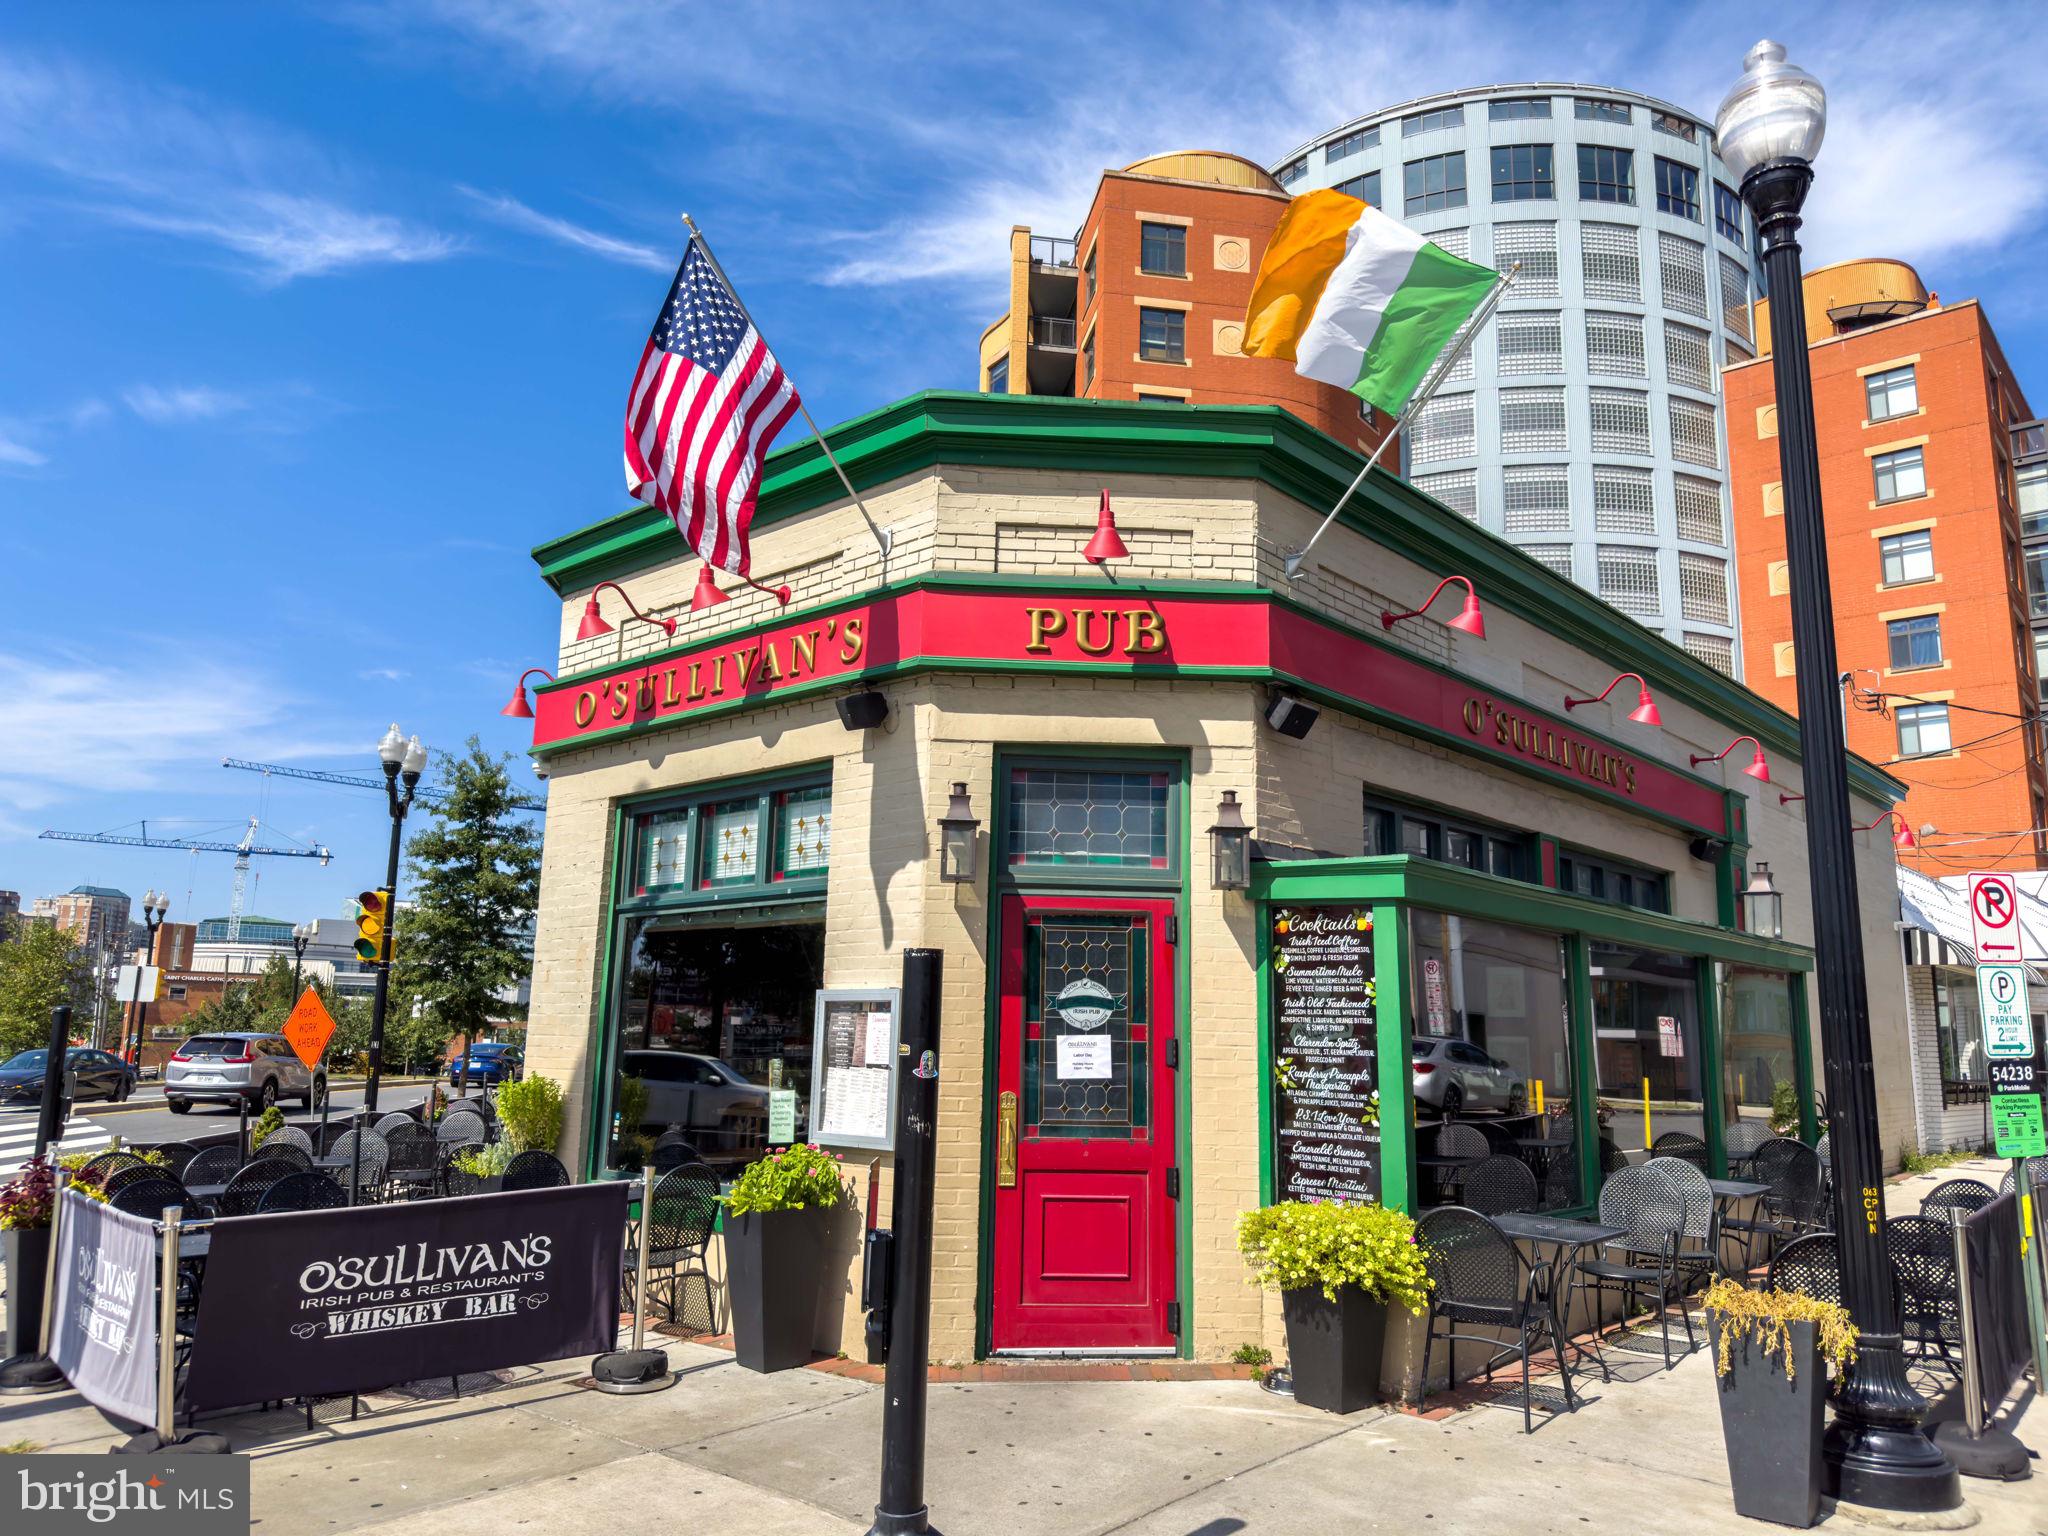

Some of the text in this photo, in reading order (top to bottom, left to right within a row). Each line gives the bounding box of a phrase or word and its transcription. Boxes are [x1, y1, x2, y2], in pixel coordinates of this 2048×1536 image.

[1025, 608, 1166, 654] PUB
[573, 619, 864, 728] O'SULLIVAN'S
[1463, 697, 1637, 794] O'SULLIVAN'S
[1289, 914, 1356, 934] Cocktails
[1288, 935, 1360, 950] Irish Iced Coffee
[1287, 964, 1364, 976] Summertime Mule
[1064, 982, 1078, 995] FOOD
[1998, 976, 2008, 999] P
[1282, 996, 1371, 1008] Irish Old Fashioned
[299, 1008, 317, 1018] ROAD
[1998, 1004, 2012, 1014] PAY
[1990, 1016, 2023, 1025] PARKING
[299, 1023, 318, 1033] WORK
[1998, 1027, 2005, 1042] 2
[297, 1037, 321, 1048] AHEAD
[1294, 1035, 1361, 1053] Clarendon Spritz
[1288, 1065, 1370, 1085] Raspberry Pineapple
[1992, 1066, 2033, 1082] 54238
[1306, 1079, 1351, 1093] Margarita
[1286, 1089, 1308, 1097] MILAGRO,
[1299, 1098, 1324, 1106] PINEAPPLE
[1296, 1108, 1359, 1127] P.S. I Love You
[1313, 1123, 1343, 1131] STRAWBERRY
[1338, 1133, 1362, 1141] CHOCOLATE
[1292, 1140, 1366, 1158] Emerald Sunrise
[1290, 1153, 1311, 1161] JAMESON
[1312, 1156, 1332, 1164] ORANGE,
[1332, 1157, 1349, 1165] MELON
[1343, 1166, 1360, 1174] SPRITE
[1291, 1171, 1368, 1192] Espresso Martini
[1288, 1185, 1305, 1193] KETTLE
[1863, 1187, 1877, 1196] 063
[1863, 1198, 1878, 1208] CP
[1869, 1223, 1877, 1234] N
[300, 1233, 552, 1294] O'SULLIVAN'S
[300, 1271, 545, 1310] IRISH PUB & RESTAURANT'S
[327, 1292, 517, 1335] WHISKEY BAR
